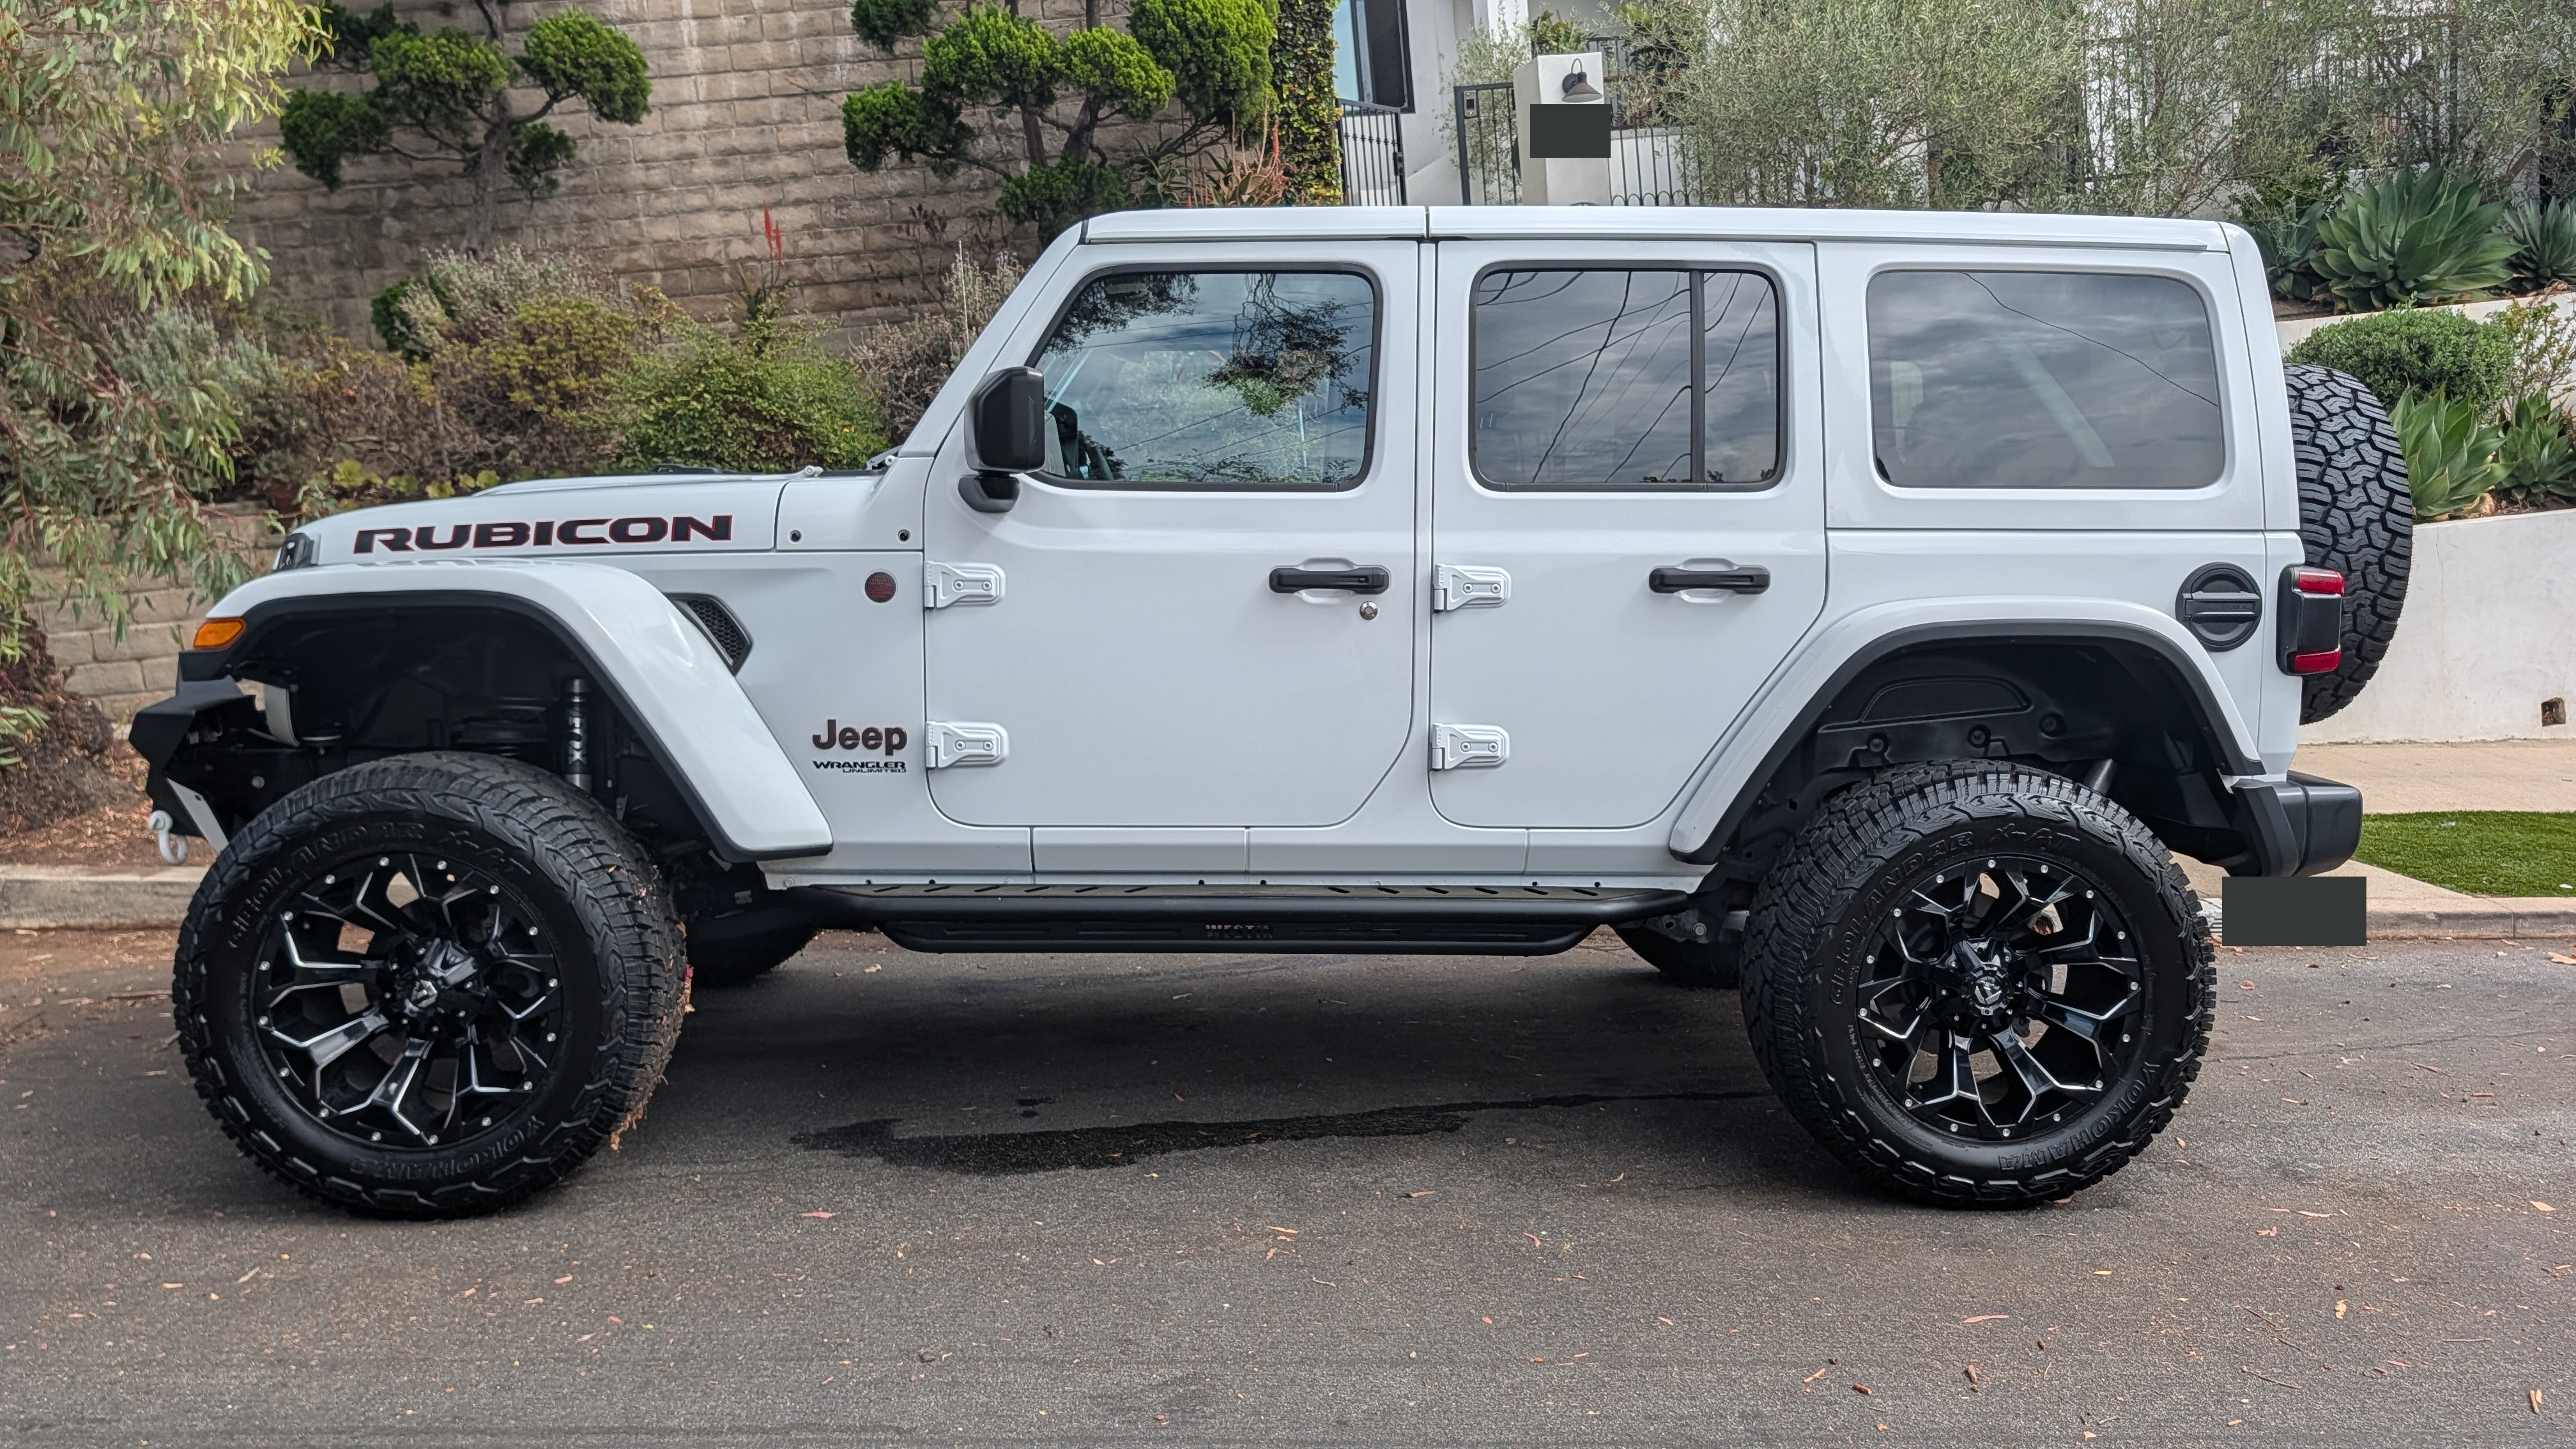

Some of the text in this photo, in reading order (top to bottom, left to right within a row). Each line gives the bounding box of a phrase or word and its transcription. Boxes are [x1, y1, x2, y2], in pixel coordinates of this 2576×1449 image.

[353, 514, 733, 555] RUBICON
[812, 719, 907, 756] Jeep
[812, 760, 906, 769] WRANGLER
[1998, 1061, 2160, 1170] YOKOHAMA
